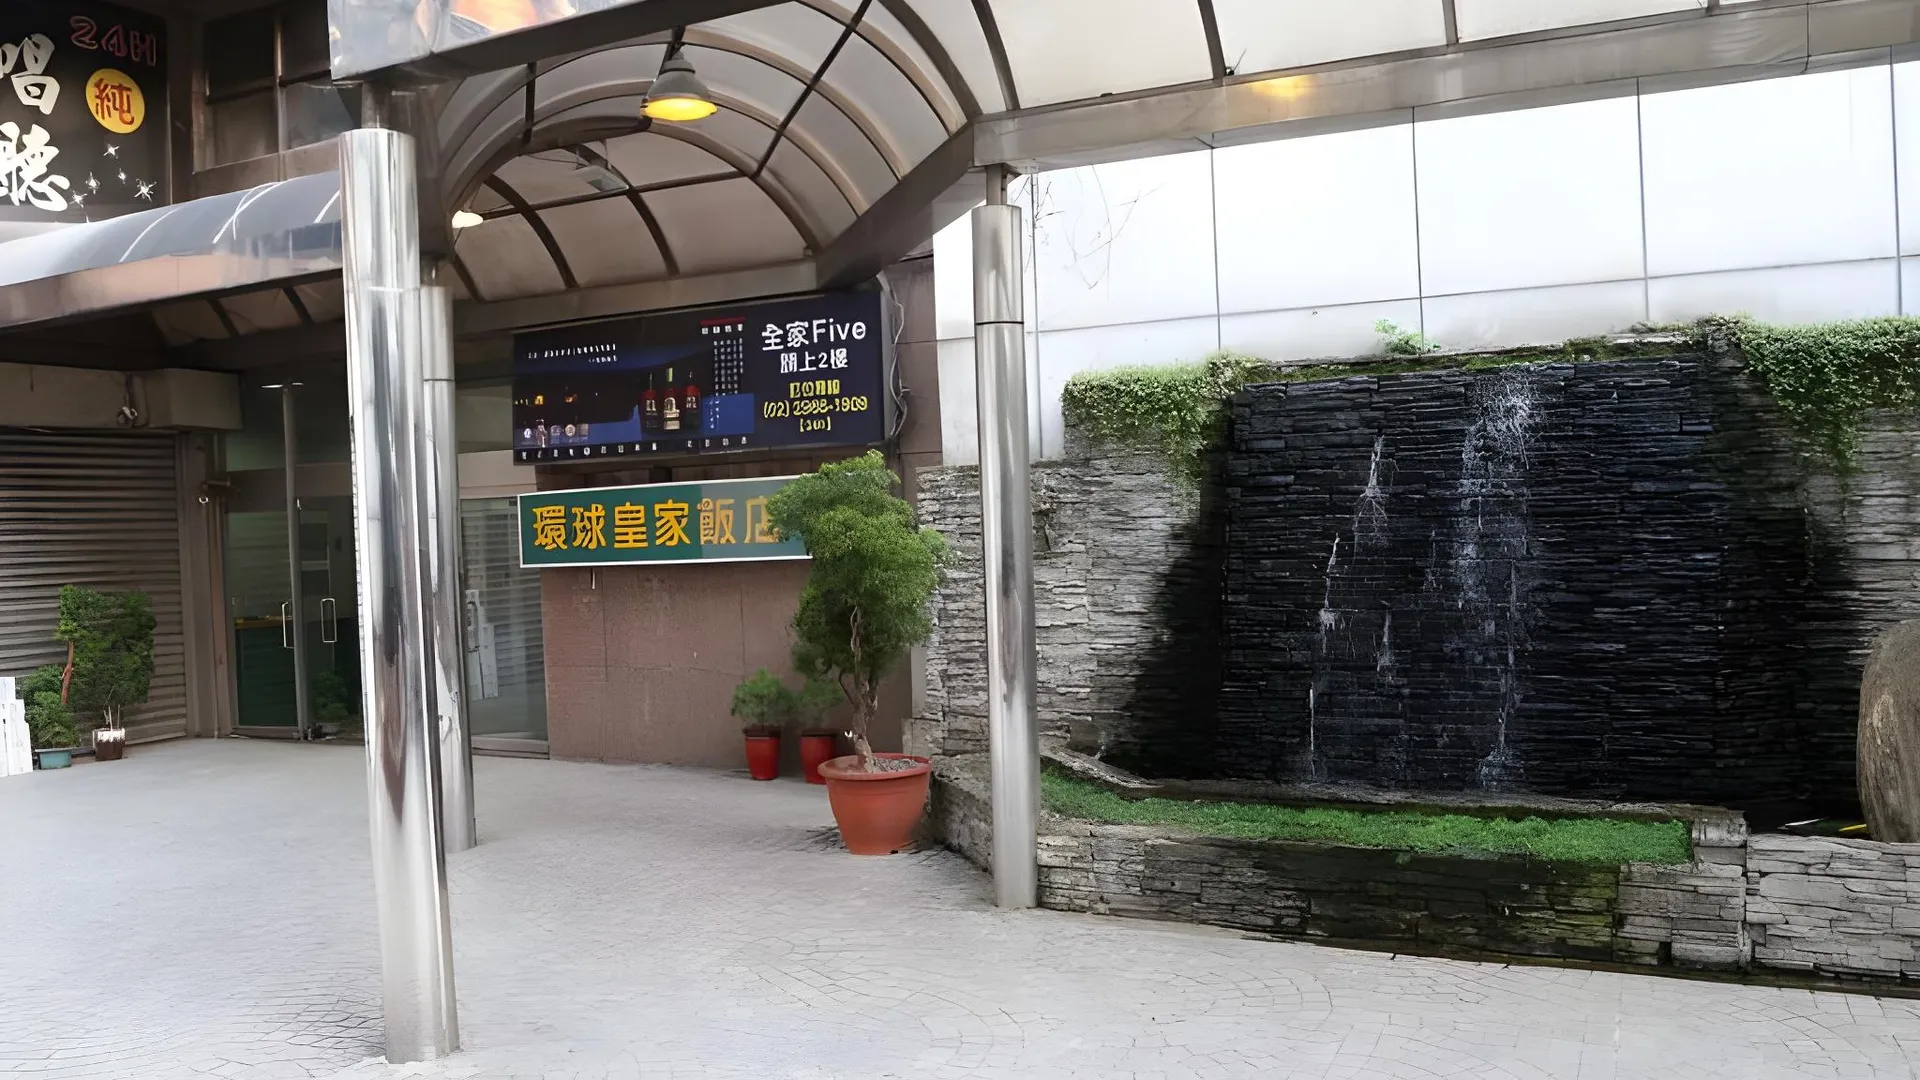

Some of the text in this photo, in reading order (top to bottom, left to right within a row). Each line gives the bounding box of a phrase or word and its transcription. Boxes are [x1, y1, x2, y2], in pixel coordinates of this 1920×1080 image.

[69, 15, 157, 67] 24H
[93, 77, 135, 126] 純
[531, 495, 780, 551] 環球皇家飯店
